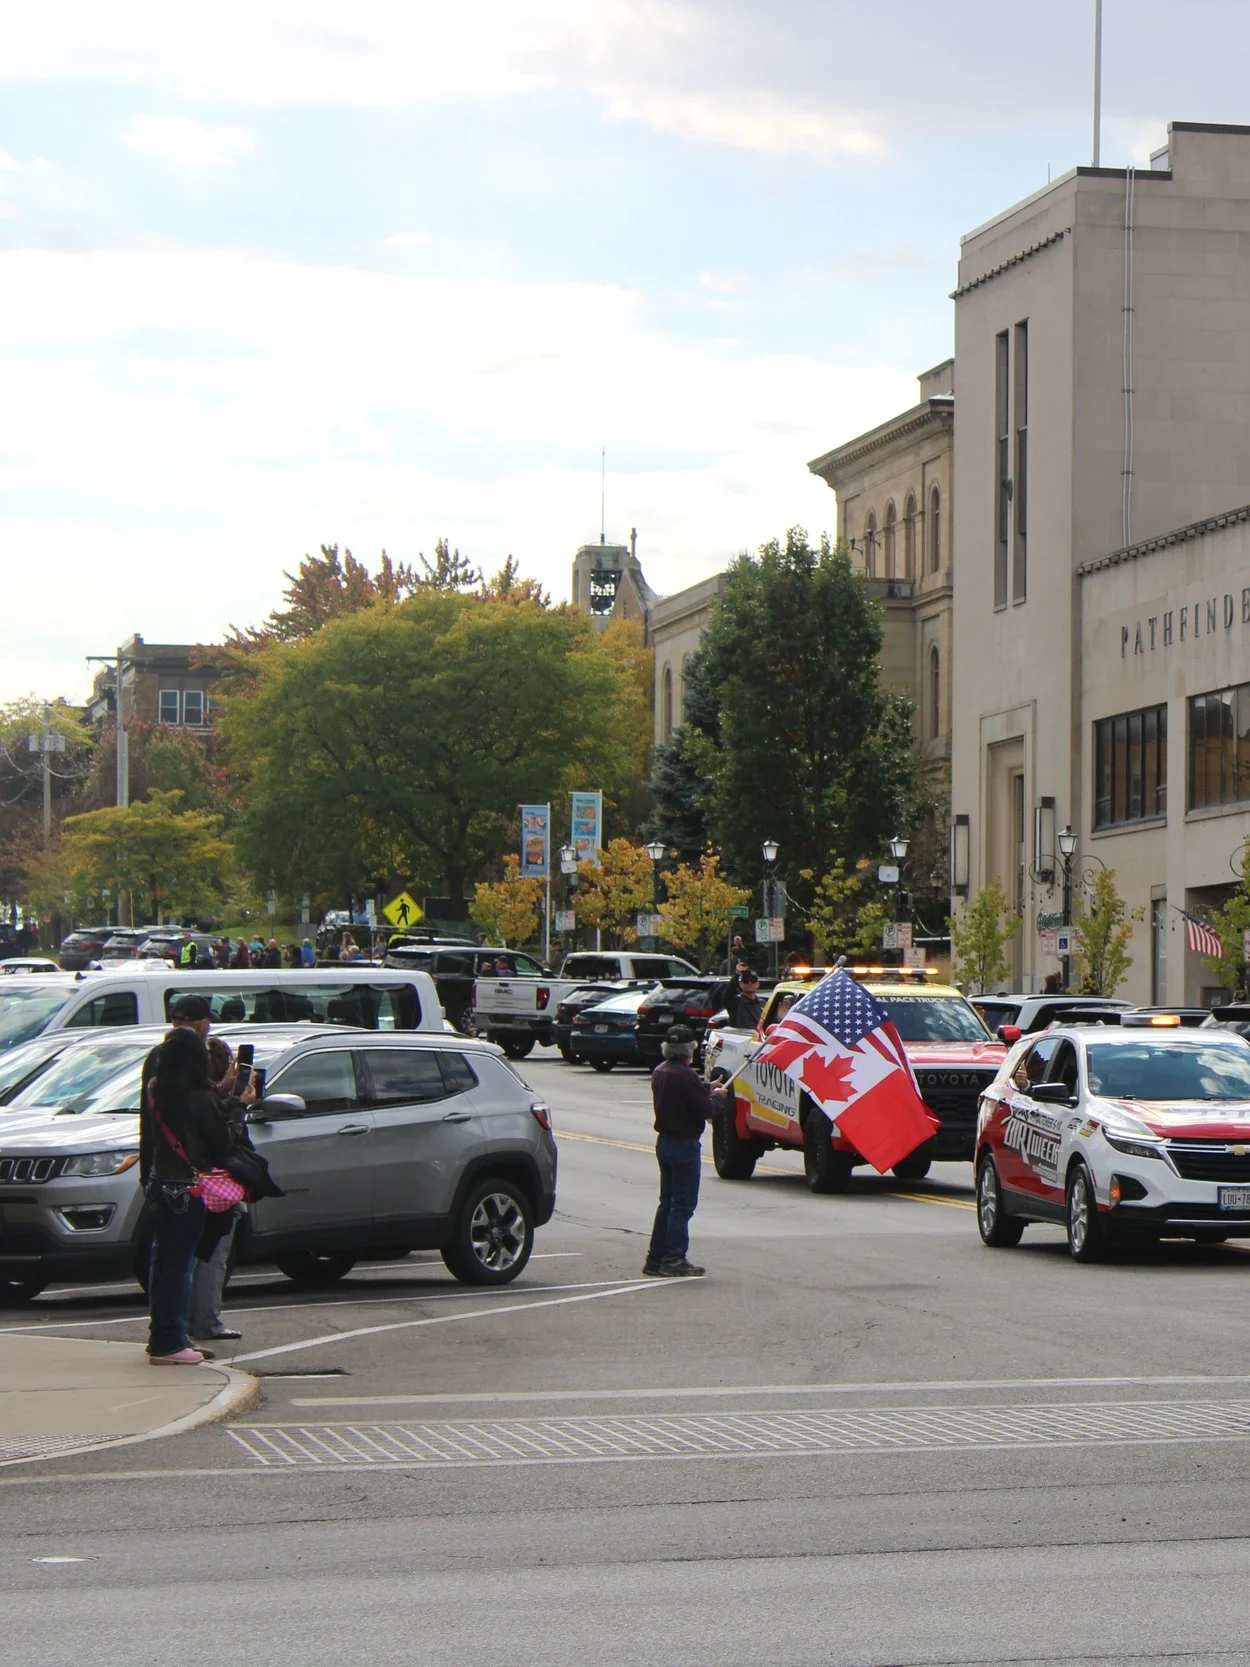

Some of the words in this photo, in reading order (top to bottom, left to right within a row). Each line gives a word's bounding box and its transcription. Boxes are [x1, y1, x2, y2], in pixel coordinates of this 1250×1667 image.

[916, 996, 949, 1004] TRUCK
[916, 1073, 980, 1085] TOYOTA
[755, 1092, 796, 1118] RACING
